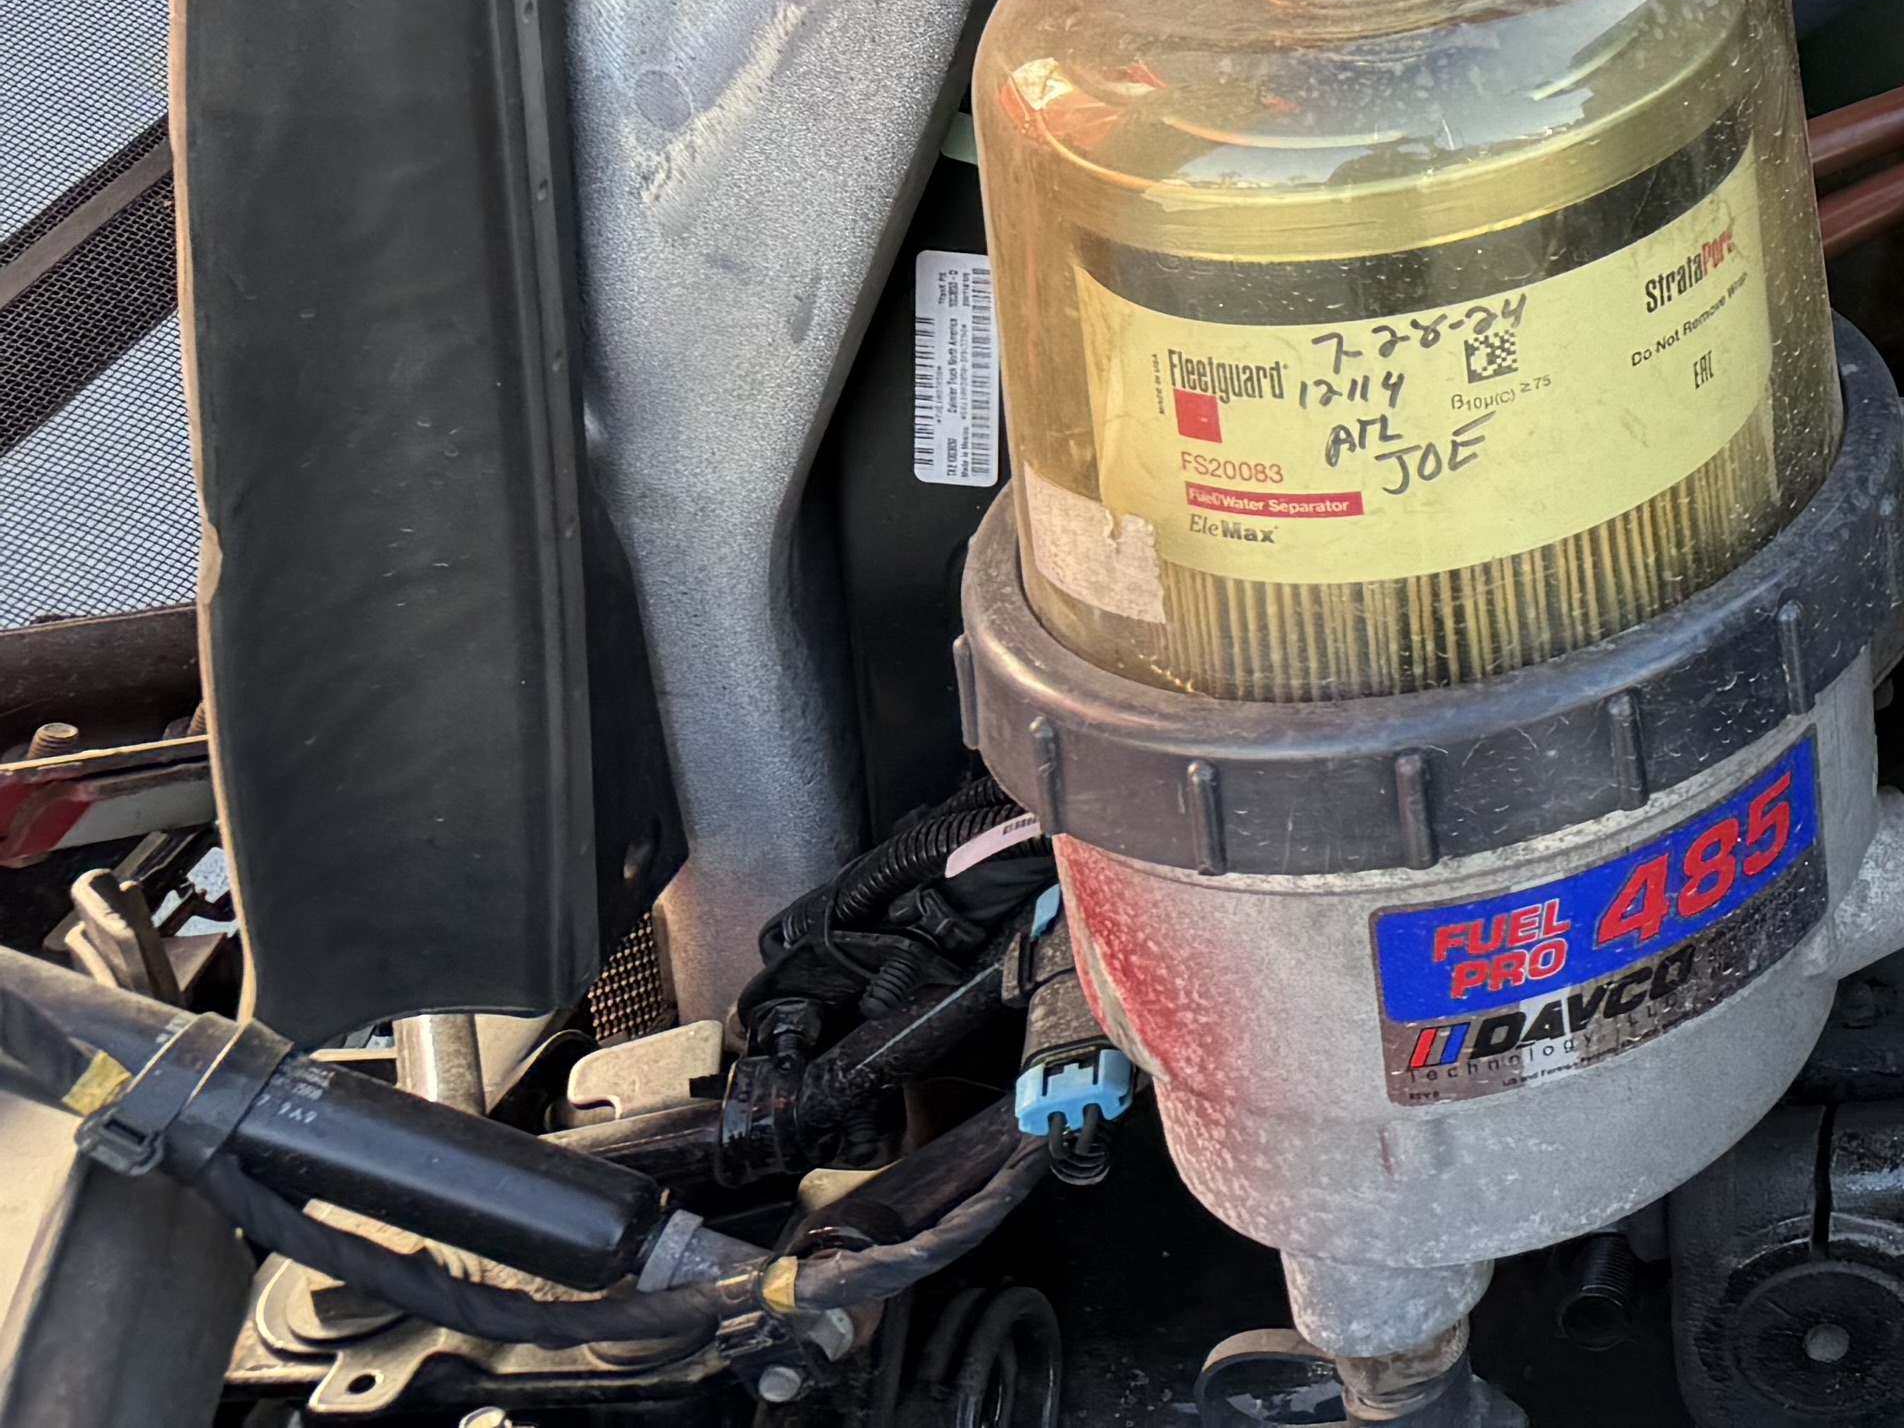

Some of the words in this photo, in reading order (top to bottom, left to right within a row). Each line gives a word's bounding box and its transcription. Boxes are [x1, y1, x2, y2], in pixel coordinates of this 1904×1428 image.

[1631, 349, 1652, 367] Do
[1655, 332, 1680, 354] Not
[1683, 295, 1726, 336] Remove
[1168, 348, 1285, 404] Fleetguard
[1180, 451, 1284, 484] FS20083
[1375, 410, 1496, 494] JOE
[1188, 486, 1265, 512] Fuel/Water
[1268, 498, 1350, 514] Separator
[1189, 513, 1275, 544] EleMax
[1594, 770, 1791, 950] 485
[1433, 898, 1571, 963] FUEL
[1451, 938, 1567, 999] PRO
[1471, 944, 1696, 1058] DAVCO
